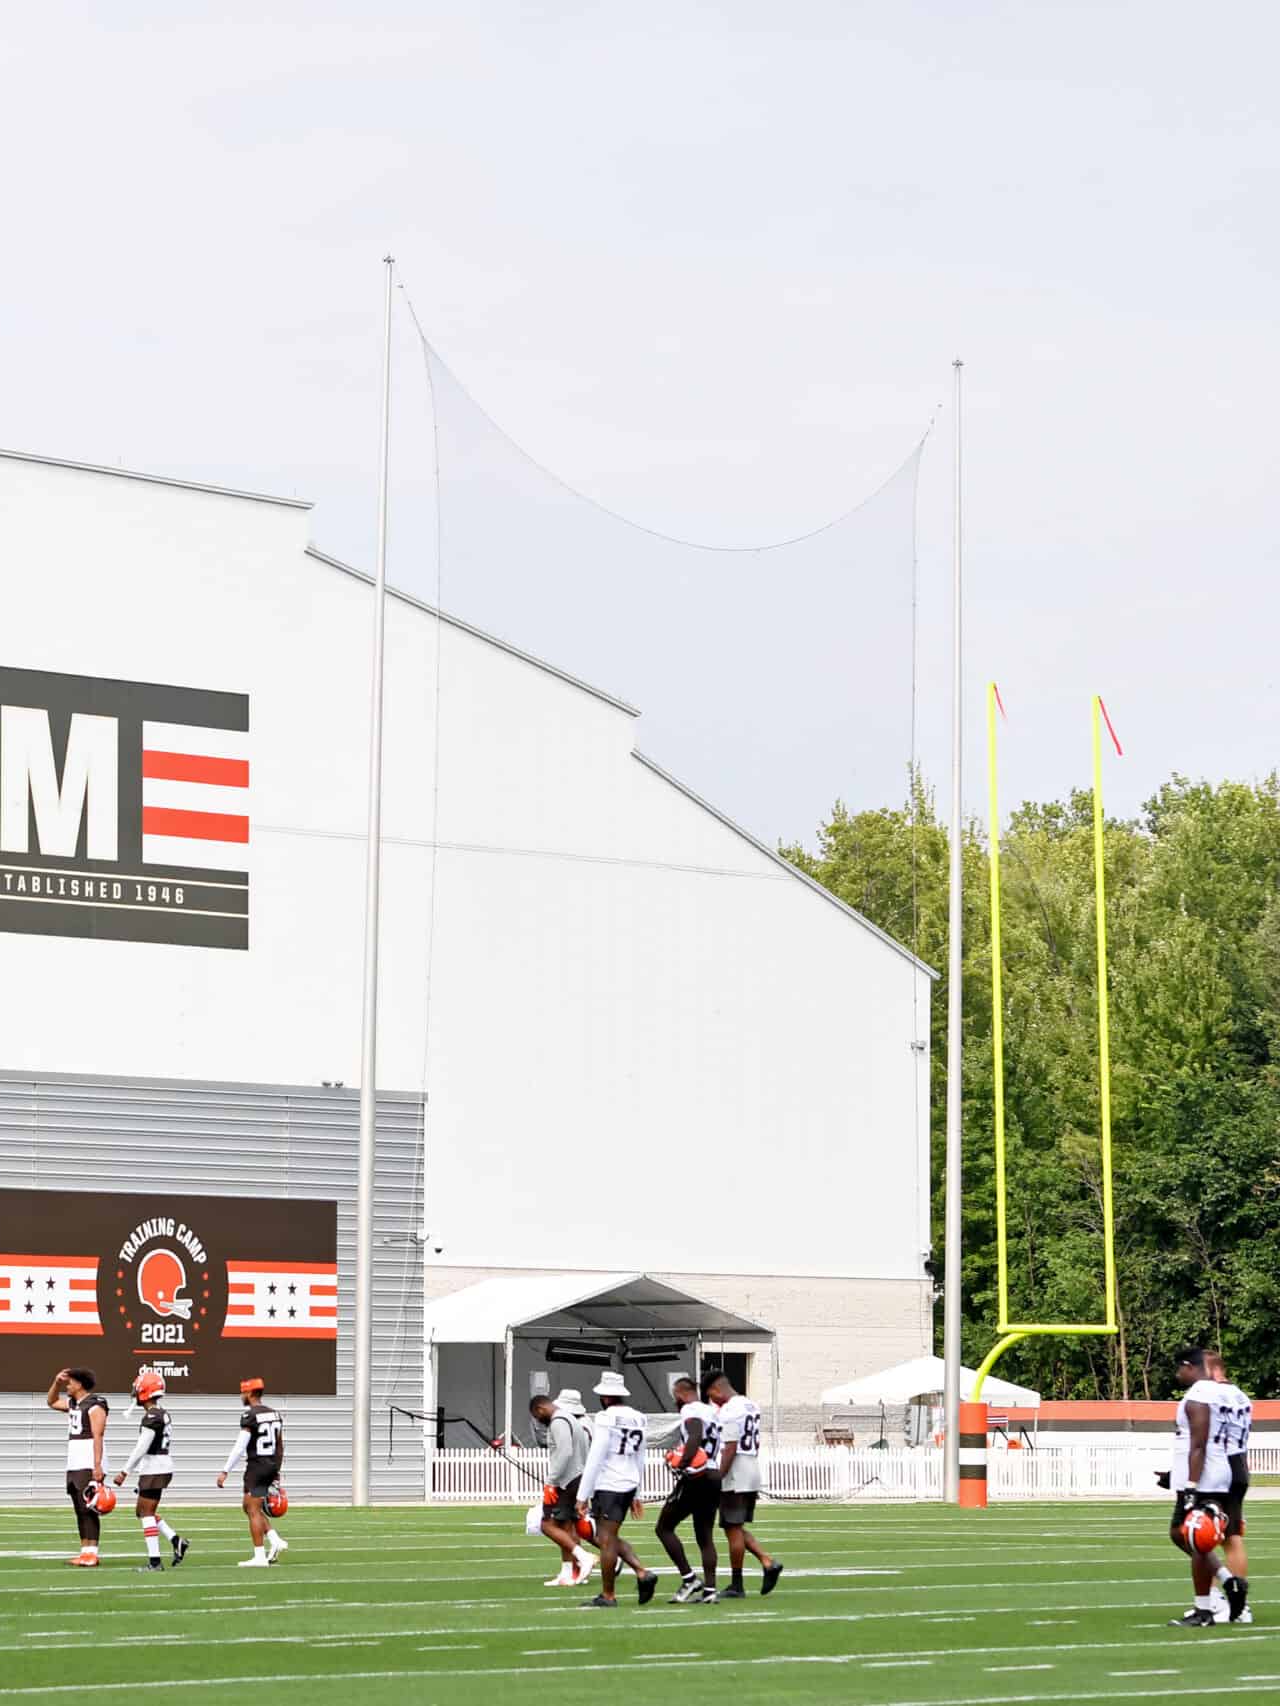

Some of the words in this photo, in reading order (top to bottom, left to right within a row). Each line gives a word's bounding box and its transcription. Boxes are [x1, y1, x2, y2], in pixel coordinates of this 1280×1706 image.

[135, 884, 185, 904] 1946
[118, 1217, 176, 1264] TRAINING
[175, 1223, 208, 1264] CAMP
[141, 1323, 185, 1344] 2021
[164, 1364, 188, 1377] mart
